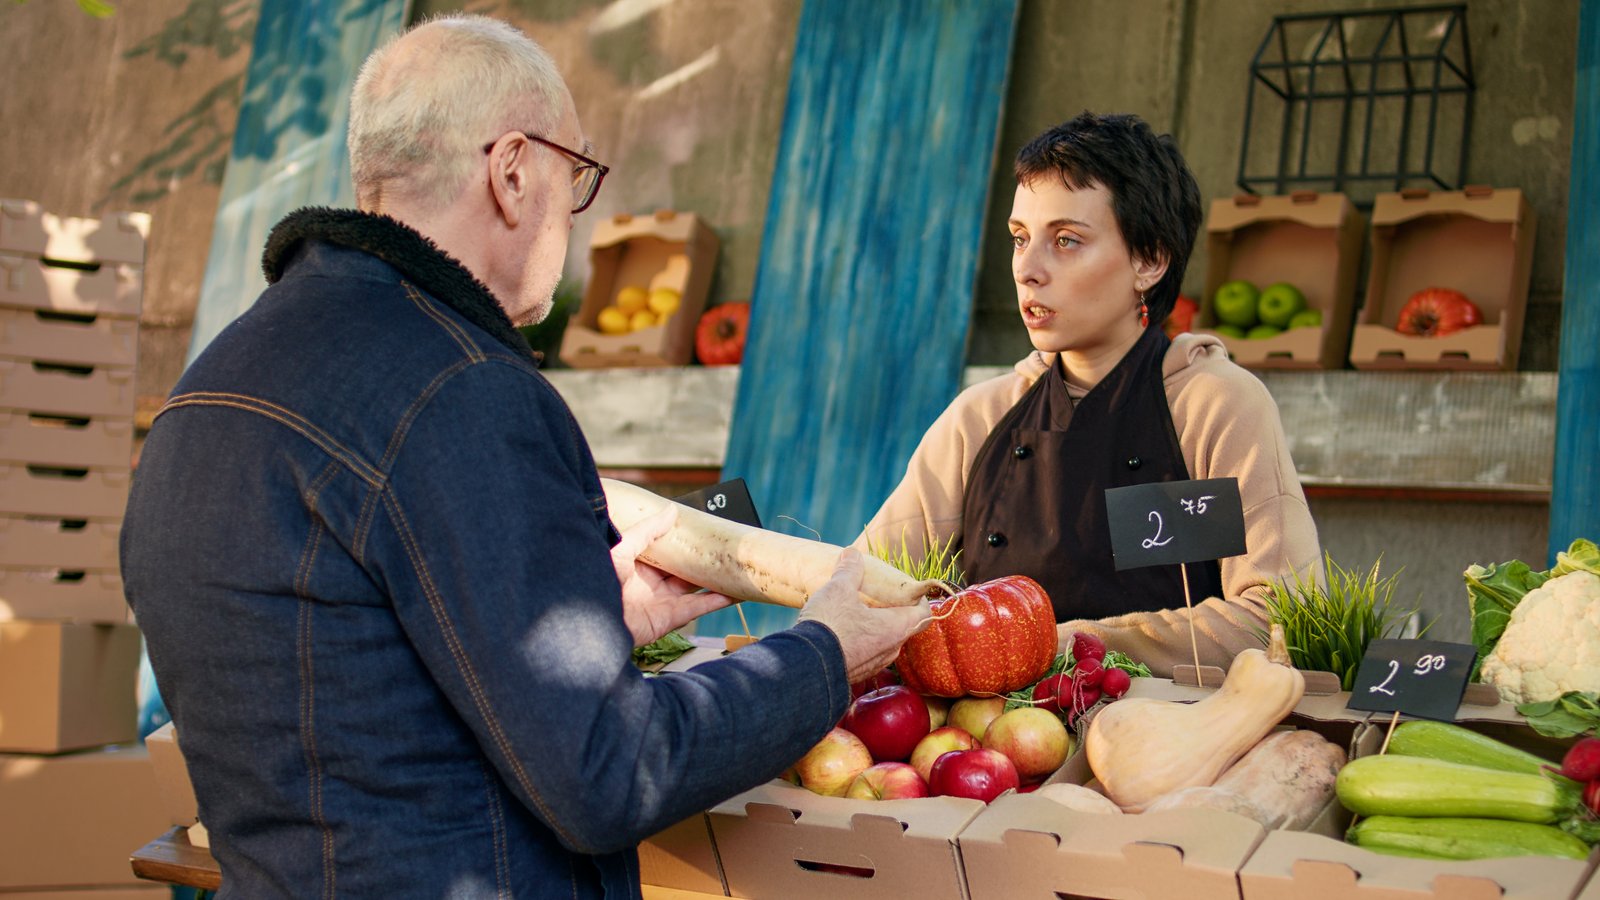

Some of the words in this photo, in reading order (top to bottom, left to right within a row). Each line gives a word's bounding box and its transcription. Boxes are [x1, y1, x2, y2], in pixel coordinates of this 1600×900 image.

[707, 493, 727, 511] 60
[1141, 510, 1174, 549] 2
[1180, 495, 1217, 515] 75
[1369, 659, 1399, 696] 2
[1413, 654, 1445, 675] 90
